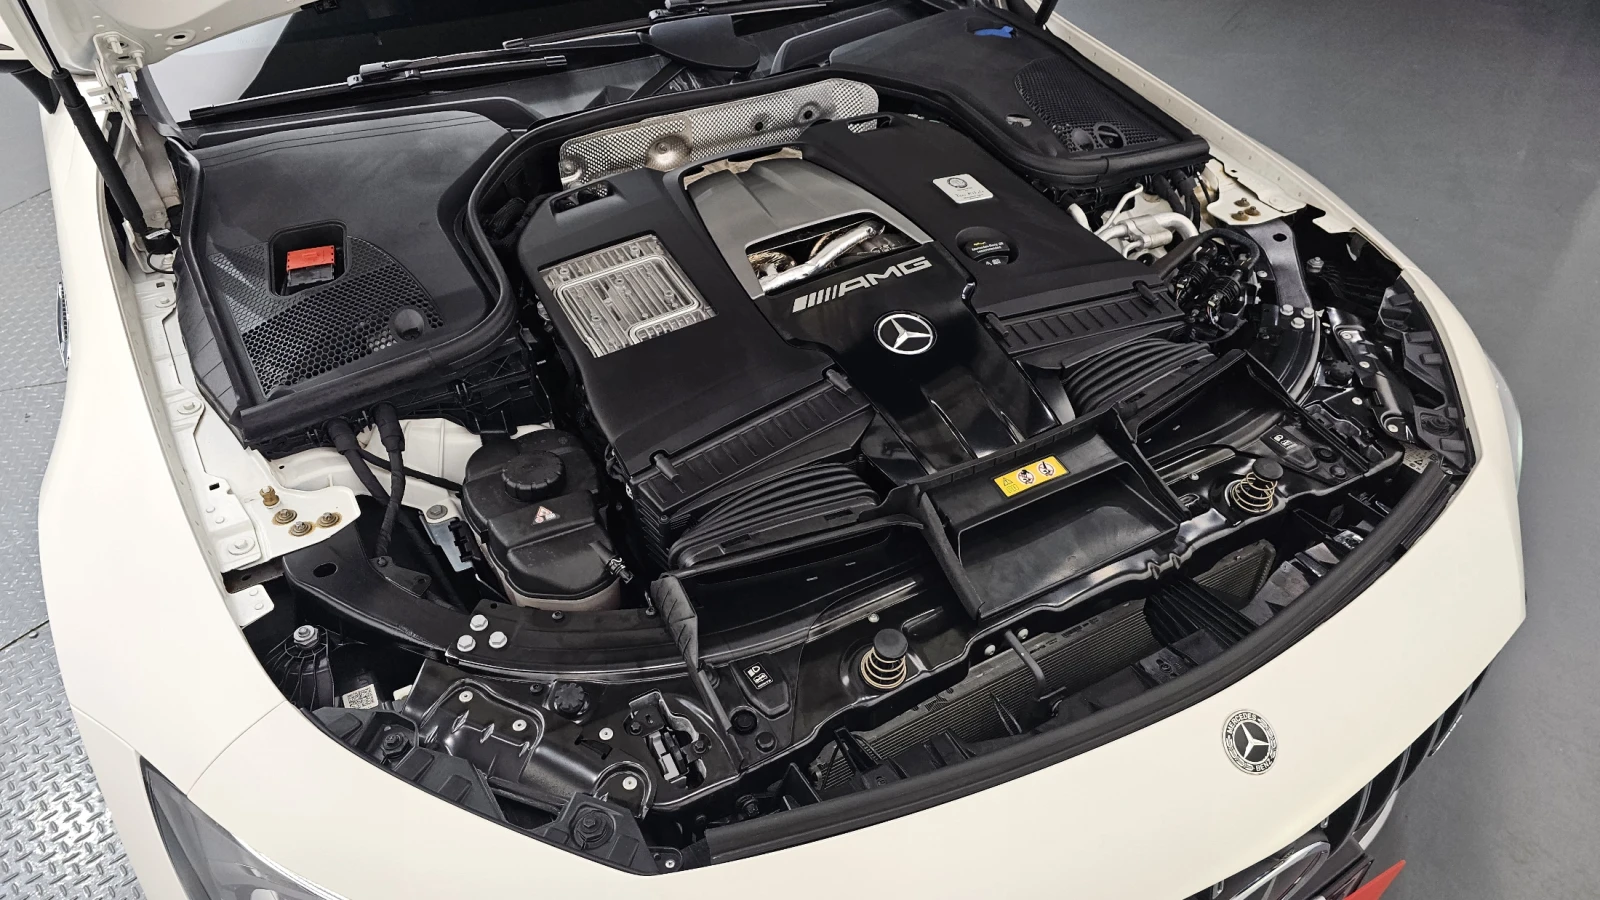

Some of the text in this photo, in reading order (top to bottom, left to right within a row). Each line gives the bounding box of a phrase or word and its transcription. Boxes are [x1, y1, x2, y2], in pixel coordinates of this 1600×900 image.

[838, 256, 932, 297] AMG
[1227, 712, 1257, 734] MERCEDES
[1256, 758, 1273, 771] BENZ
